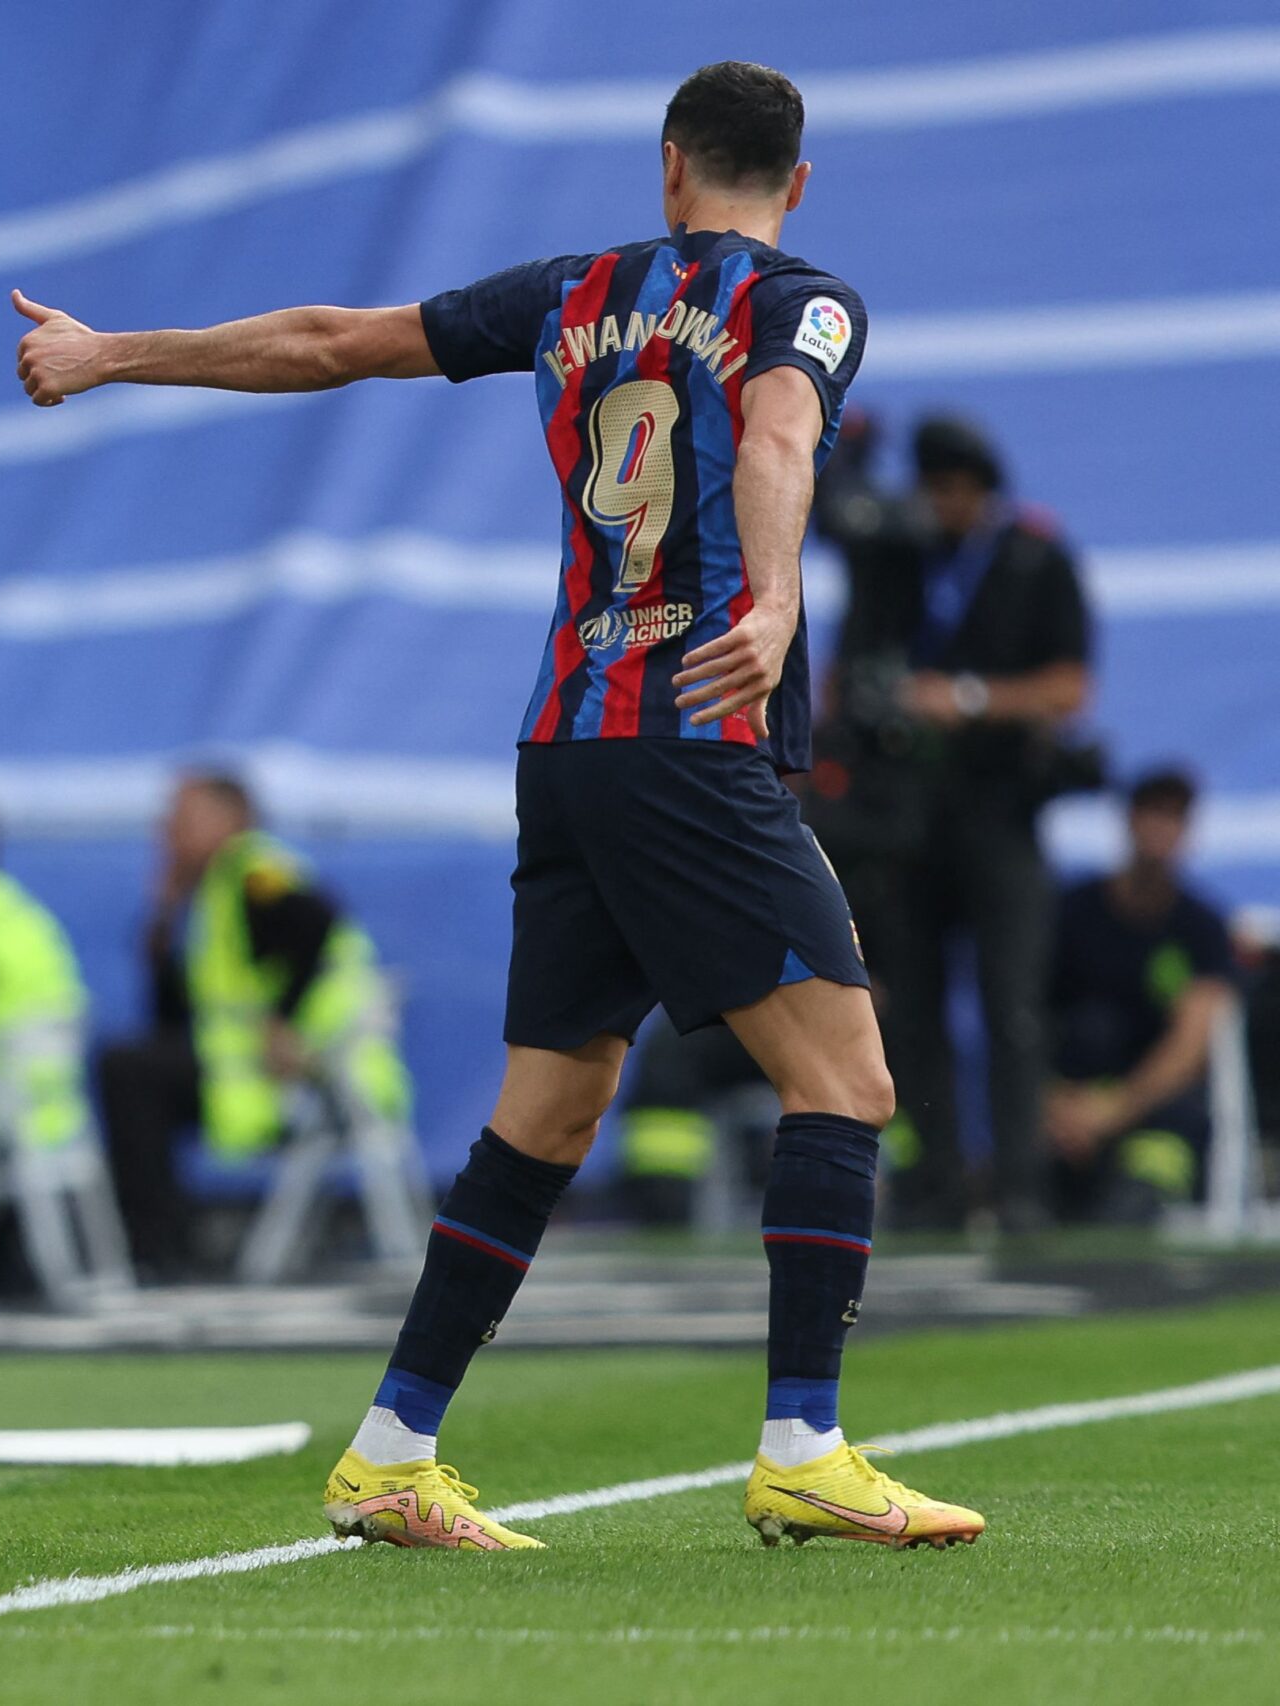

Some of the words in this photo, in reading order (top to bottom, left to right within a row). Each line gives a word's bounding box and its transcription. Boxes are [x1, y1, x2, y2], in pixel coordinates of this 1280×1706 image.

[802, 332, 838, 363] LaLiga
[583, 380, 680, 592] 9
[622, 603, 693, 626] UNHCR
